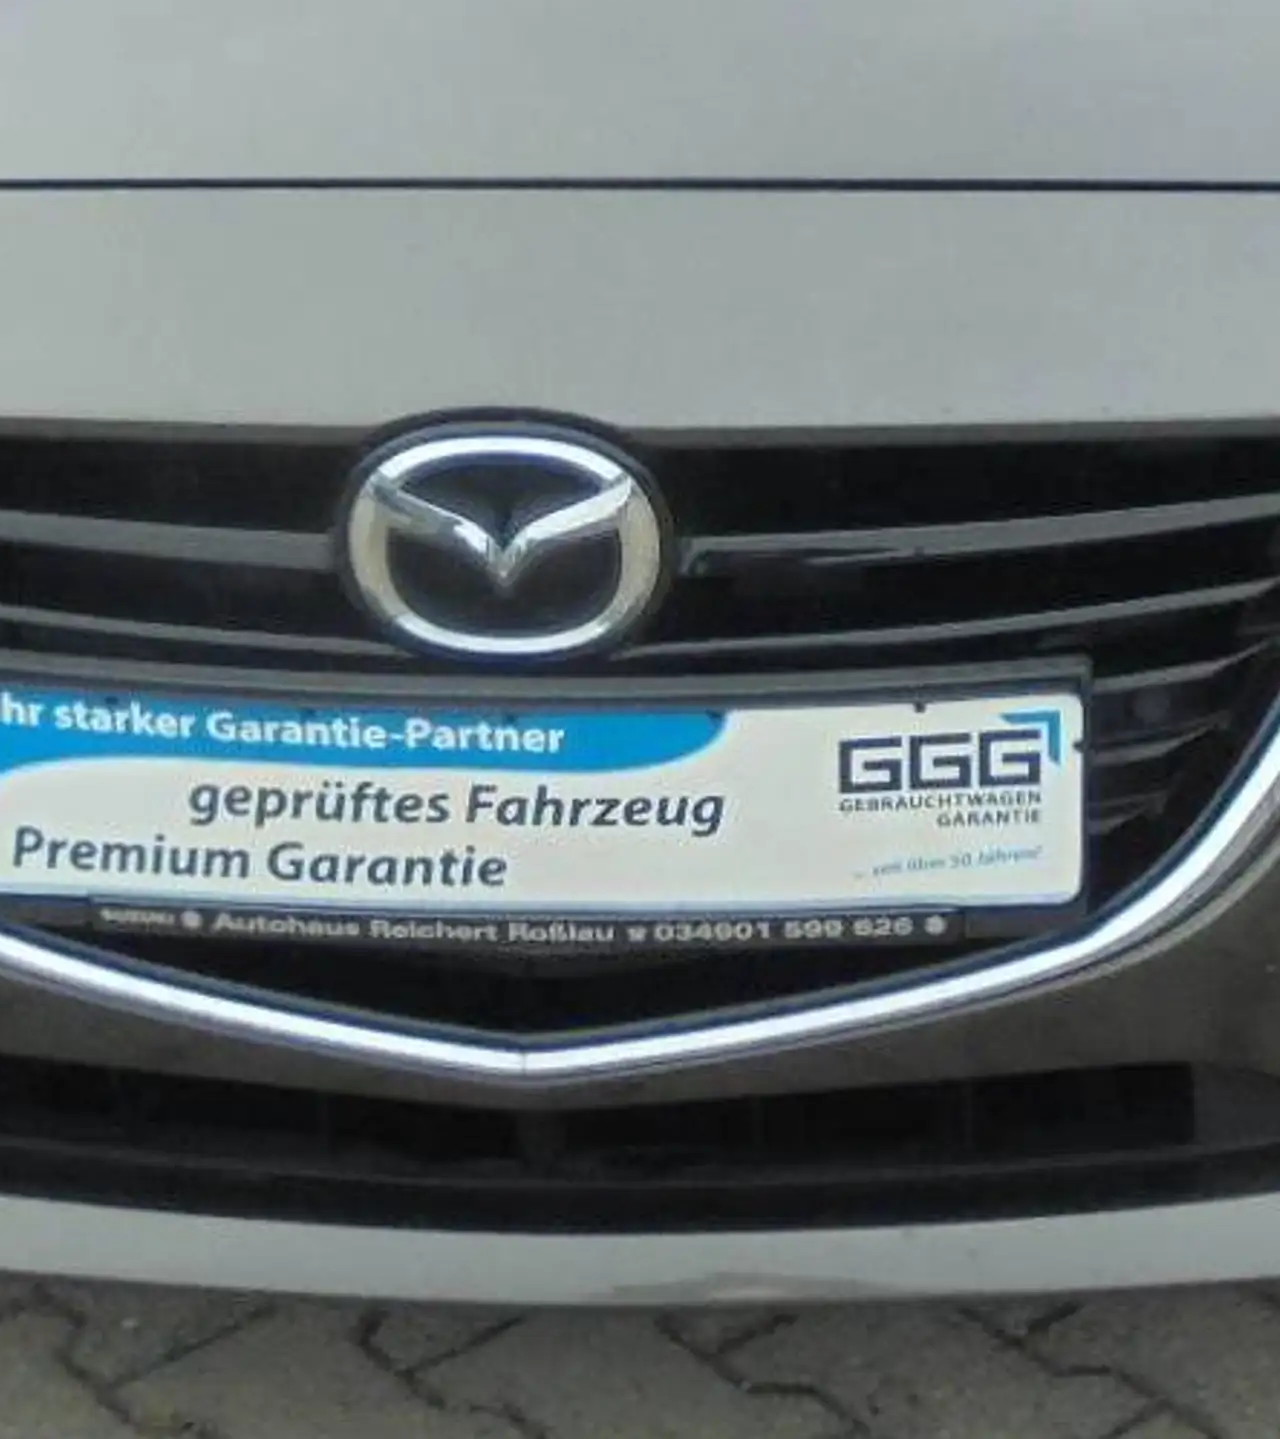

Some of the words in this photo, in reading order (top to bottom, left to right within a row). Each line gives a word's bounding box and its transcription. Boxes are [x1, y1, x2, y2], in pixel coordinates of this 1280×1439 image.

[54, 698, 194, 739] starker
[206, 710, 565, 754] Garantie-Partner
[838, 729, 1042, 794] GGG
[188, 781, 450, 828] geprüftes
[466, 783, 725, 838] Fahrzeug
[839, 790, 1042, 813] GEBRAUCHTWAGEN
[936, 808, 1042, 828] GARANTIE
[13, 825, 250, 879] Premium
[267, 839, 508, 889] Garantie
[213, 912, 361, 937] Autohaus
[370, 920, 498, 943] Reichert
[507, 921, 615, 943] Roßlau
